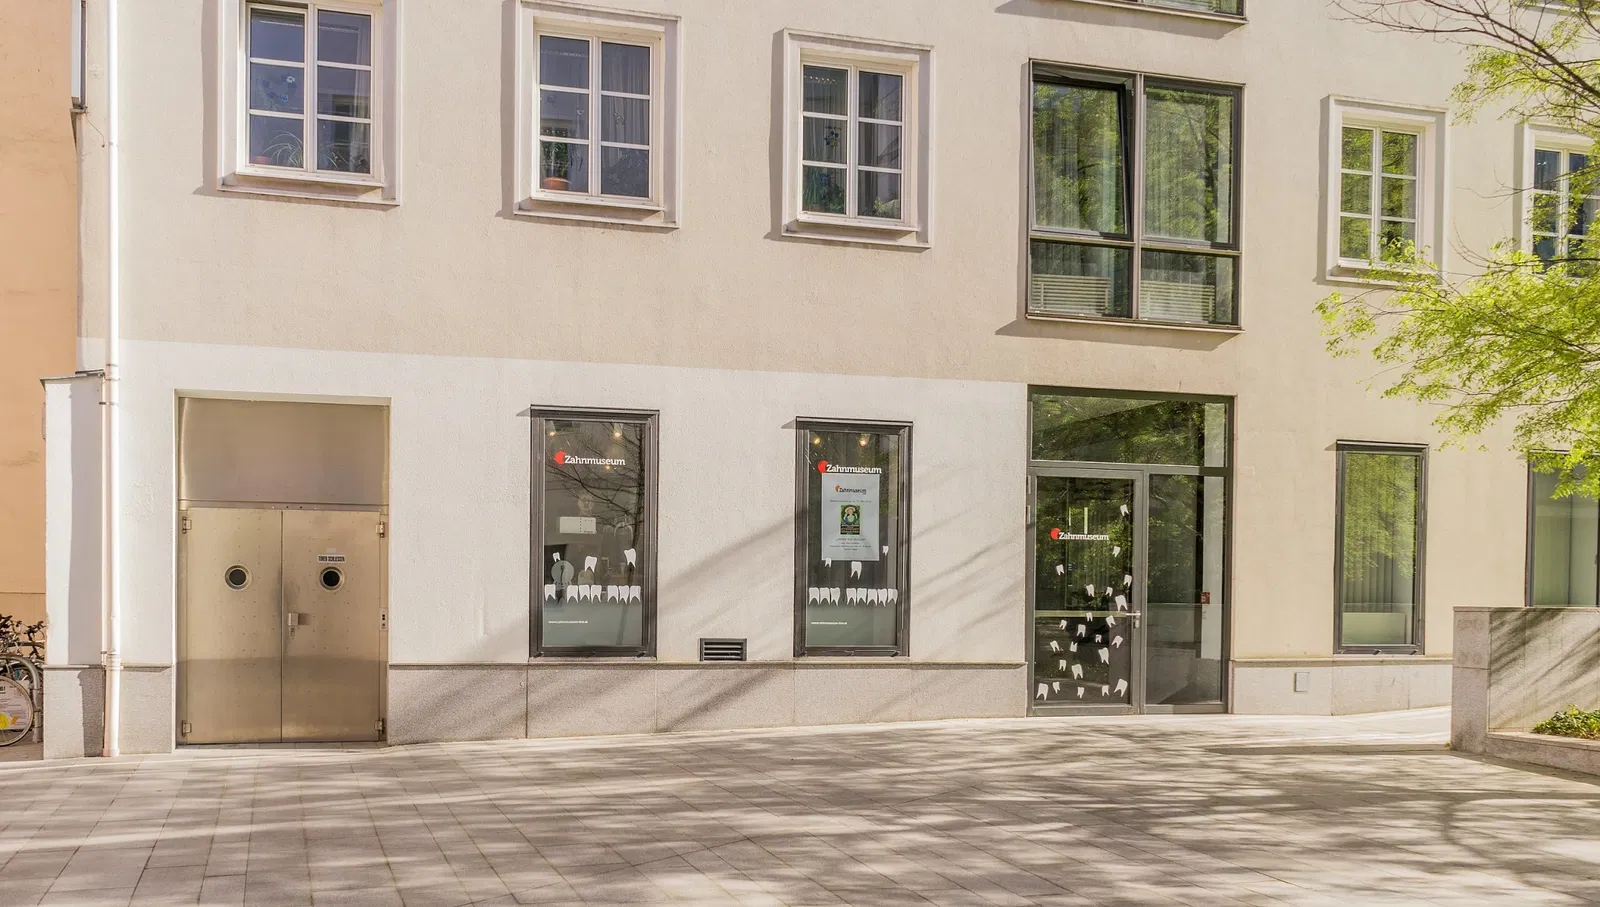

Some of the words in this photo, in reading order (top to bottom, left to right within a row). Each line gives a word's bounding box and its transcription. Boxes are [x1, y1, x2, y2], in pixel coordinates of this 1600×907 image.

[564, 455, 626, 466] Zahnmuseum
[826, 464, 882, 474] Zahnmuseum
[1058, 531, 1110, 541] Zahnmuseum
